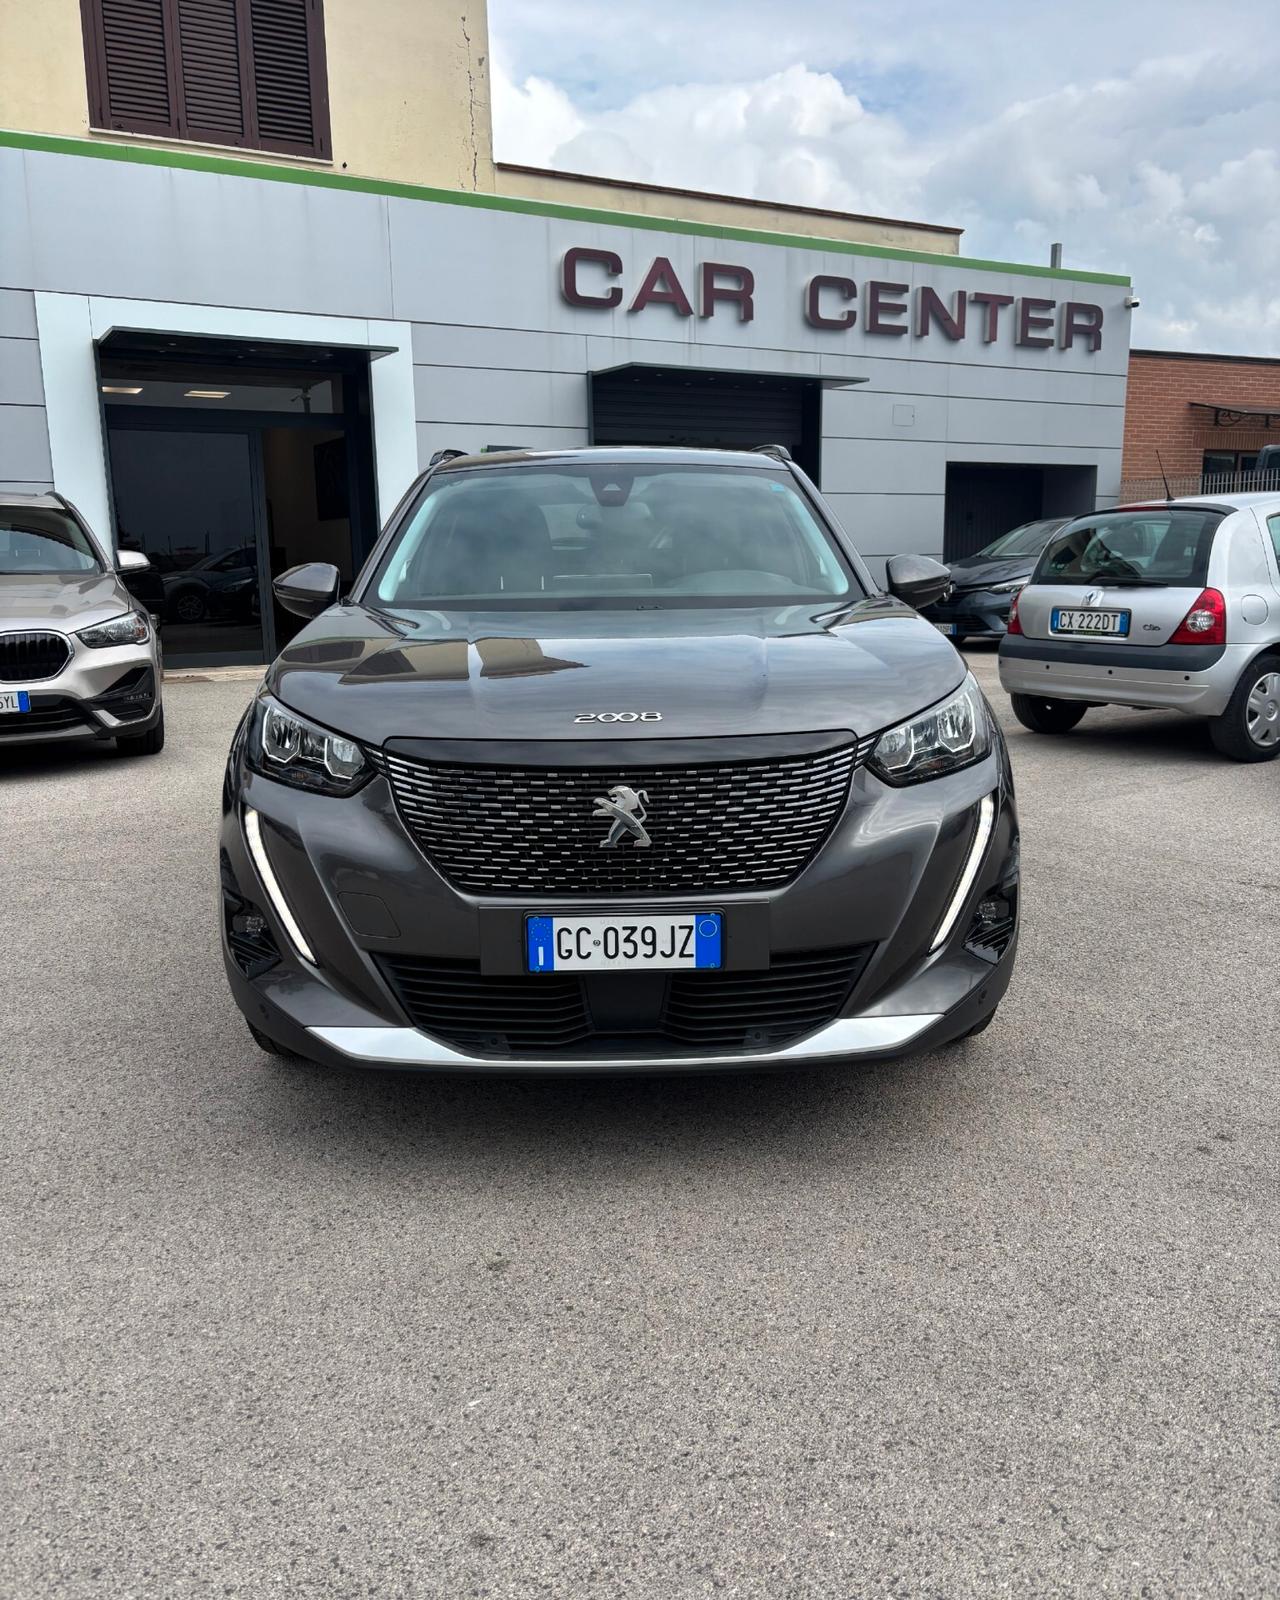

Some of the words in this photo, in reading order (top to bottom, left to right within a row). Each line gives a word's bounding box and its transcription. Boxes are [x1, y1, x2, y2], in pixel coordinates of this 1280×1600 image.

[560, 246, 755, 322] CAR
[804, 274, 1105, 352] CENTER
[1060, 612, 1074, 629] CX
[1078, 613, 1119, 631] 222DT
[1142, 623, 1161, 631] Clio
[573, 711, 663, 724] 2008
[556, 926, 592, 960] GC
[603, 925, 695, 960] 039JZ
